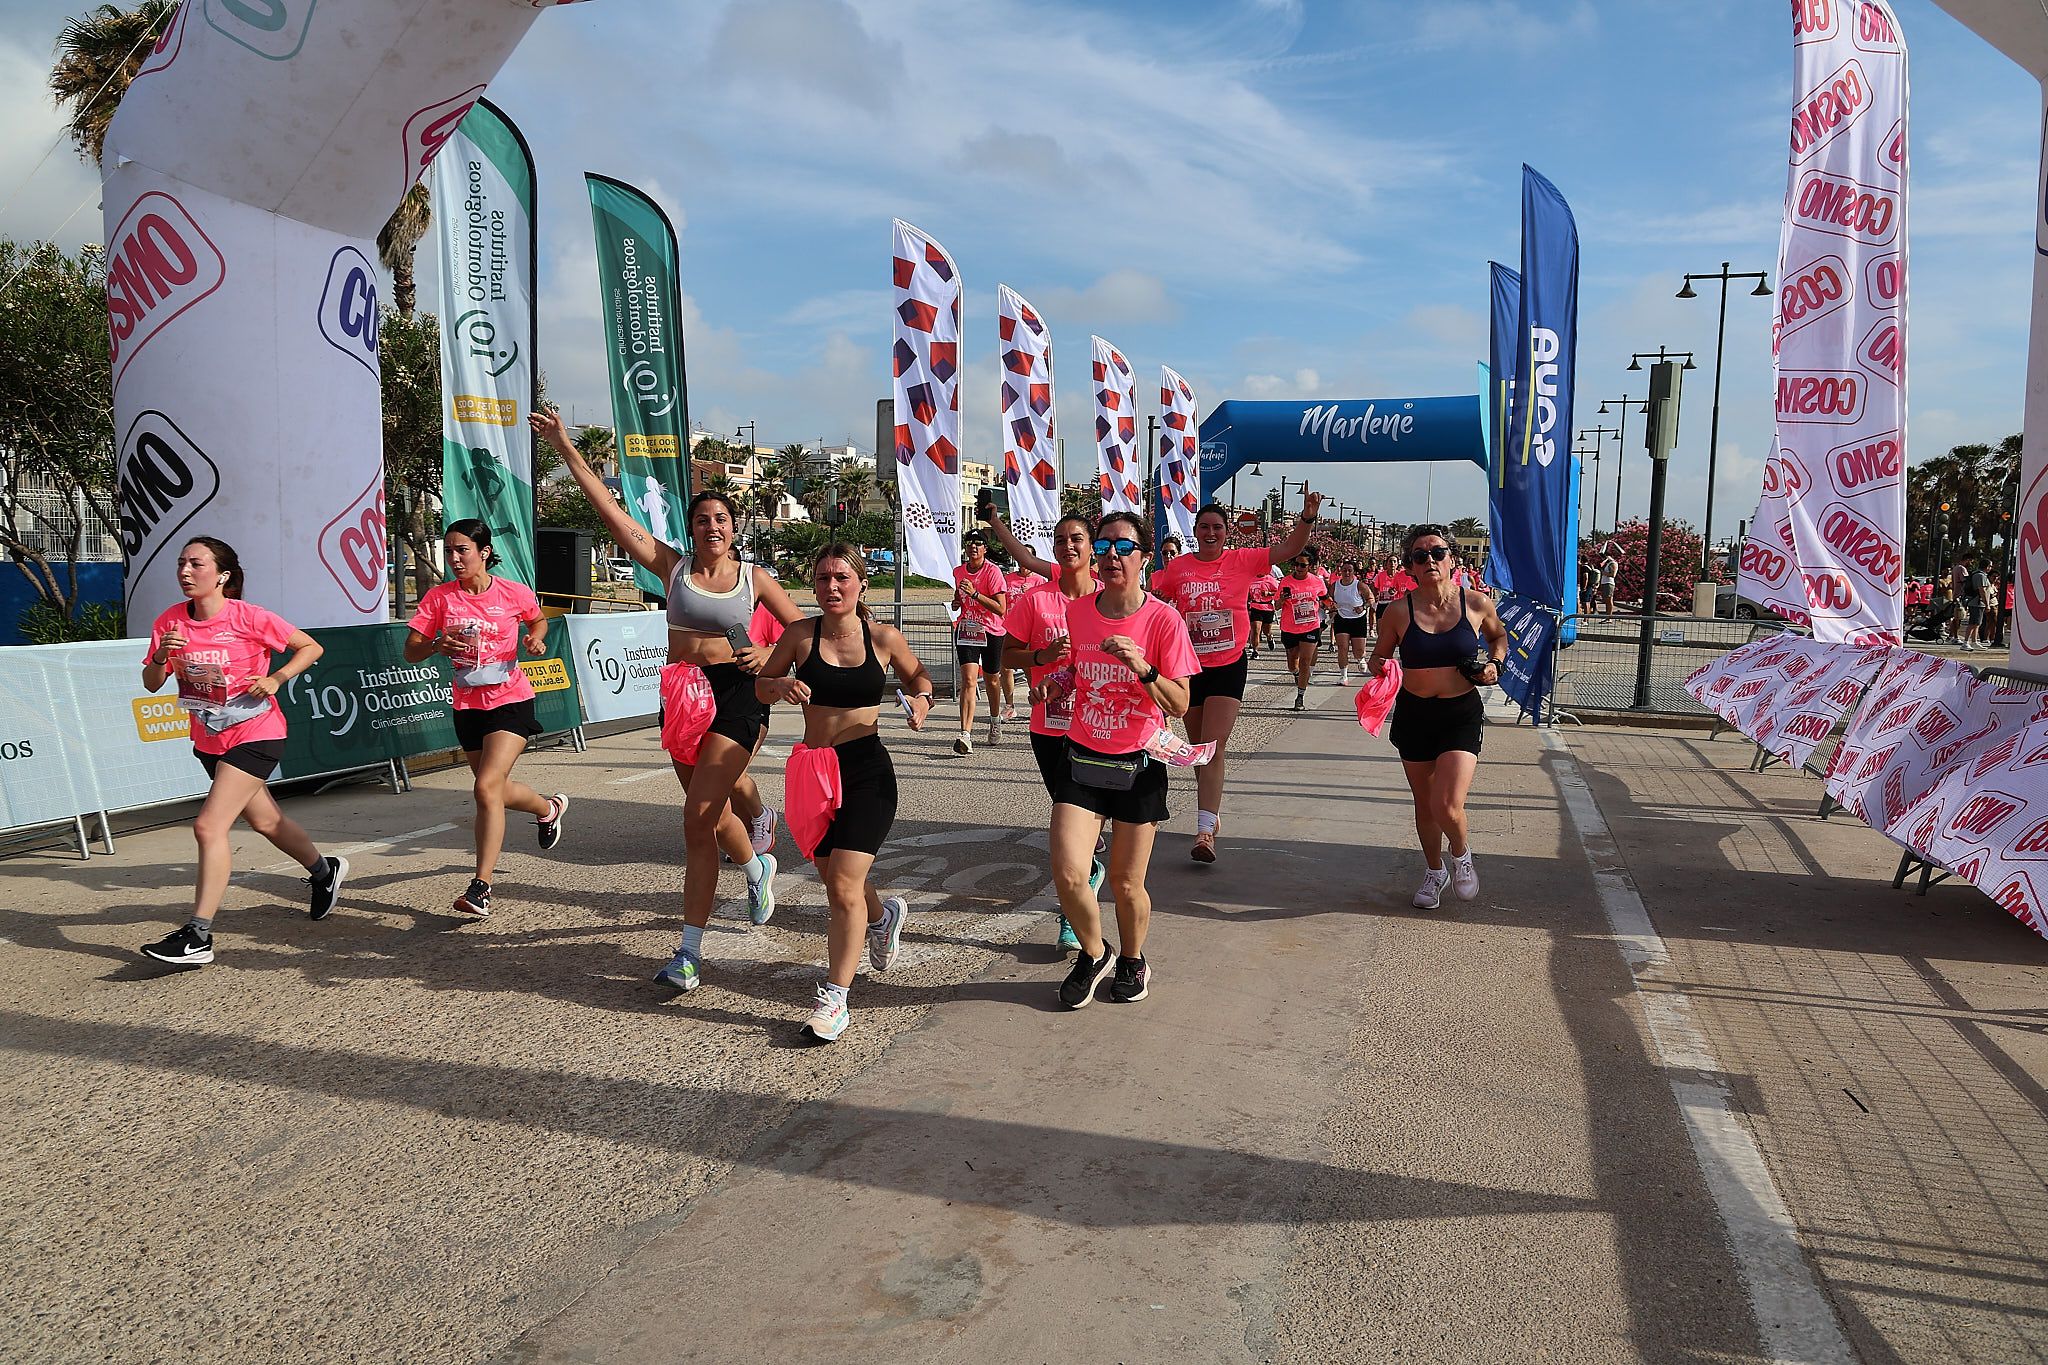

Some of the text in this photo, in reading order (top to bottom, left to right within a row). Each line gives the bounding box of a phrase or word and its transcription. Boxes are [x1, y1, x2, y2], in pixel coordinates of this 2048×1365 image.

[1300, 403, 1414, 453] Marlene
[1181, 582, 1220, 595] CARRERA
[1202, 628, 1220, 638] 016
[624, 645, 669, 661] Institutos
[357, 665, 440, 689] Institutos
[534, 665, 547, 675] 131
[1077, 661, 1136, 683] CARRERA
[193, 682, 212, 693] 016
[141, 702, 174, 719] 900
[408, 709, 445, 723] dentales
[1092, 729, 1112, 740] 2026
[1784, 715, 1831, 741] COSMO
